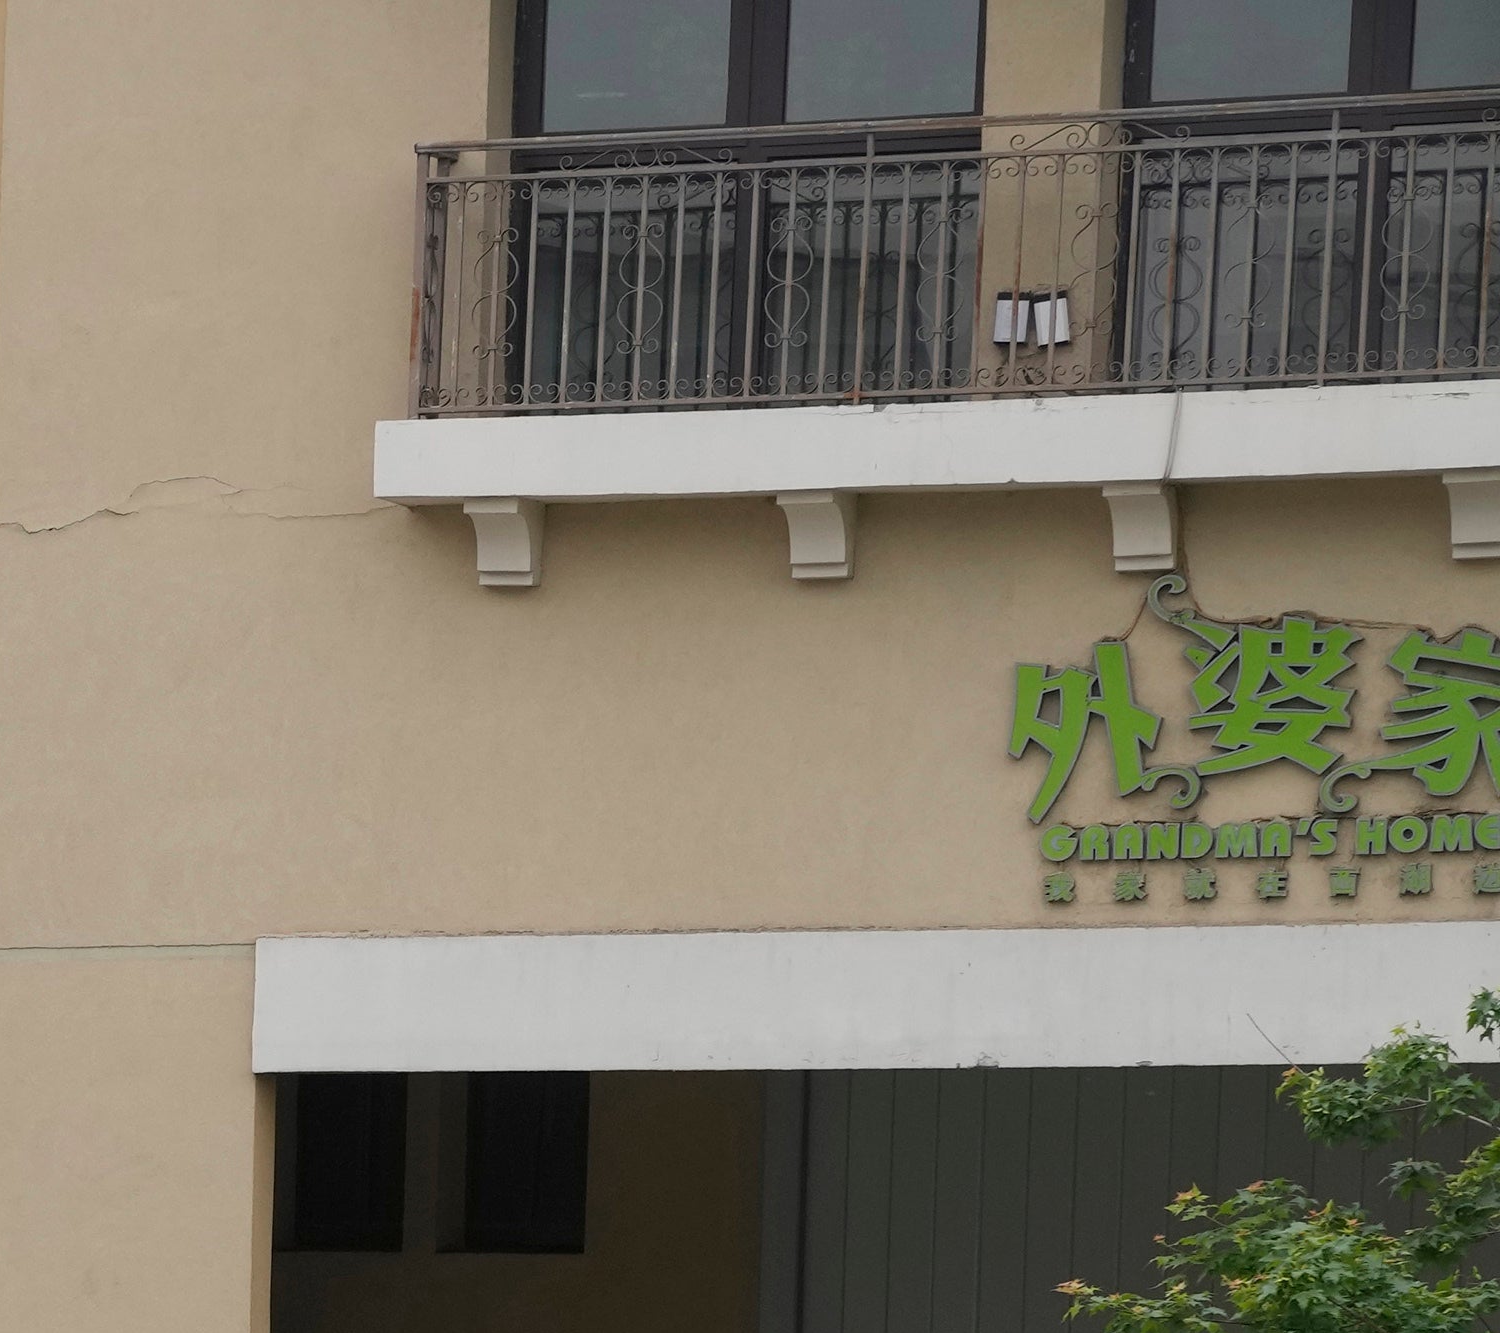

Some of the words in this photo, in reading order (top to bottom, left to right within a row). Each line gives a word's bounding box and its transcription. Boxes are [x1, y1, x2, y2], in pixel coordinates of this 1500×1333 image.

[1007, 575, 1500, 824] 外婆家
[1038, 818, 1339, 863] GRANDMA'S
